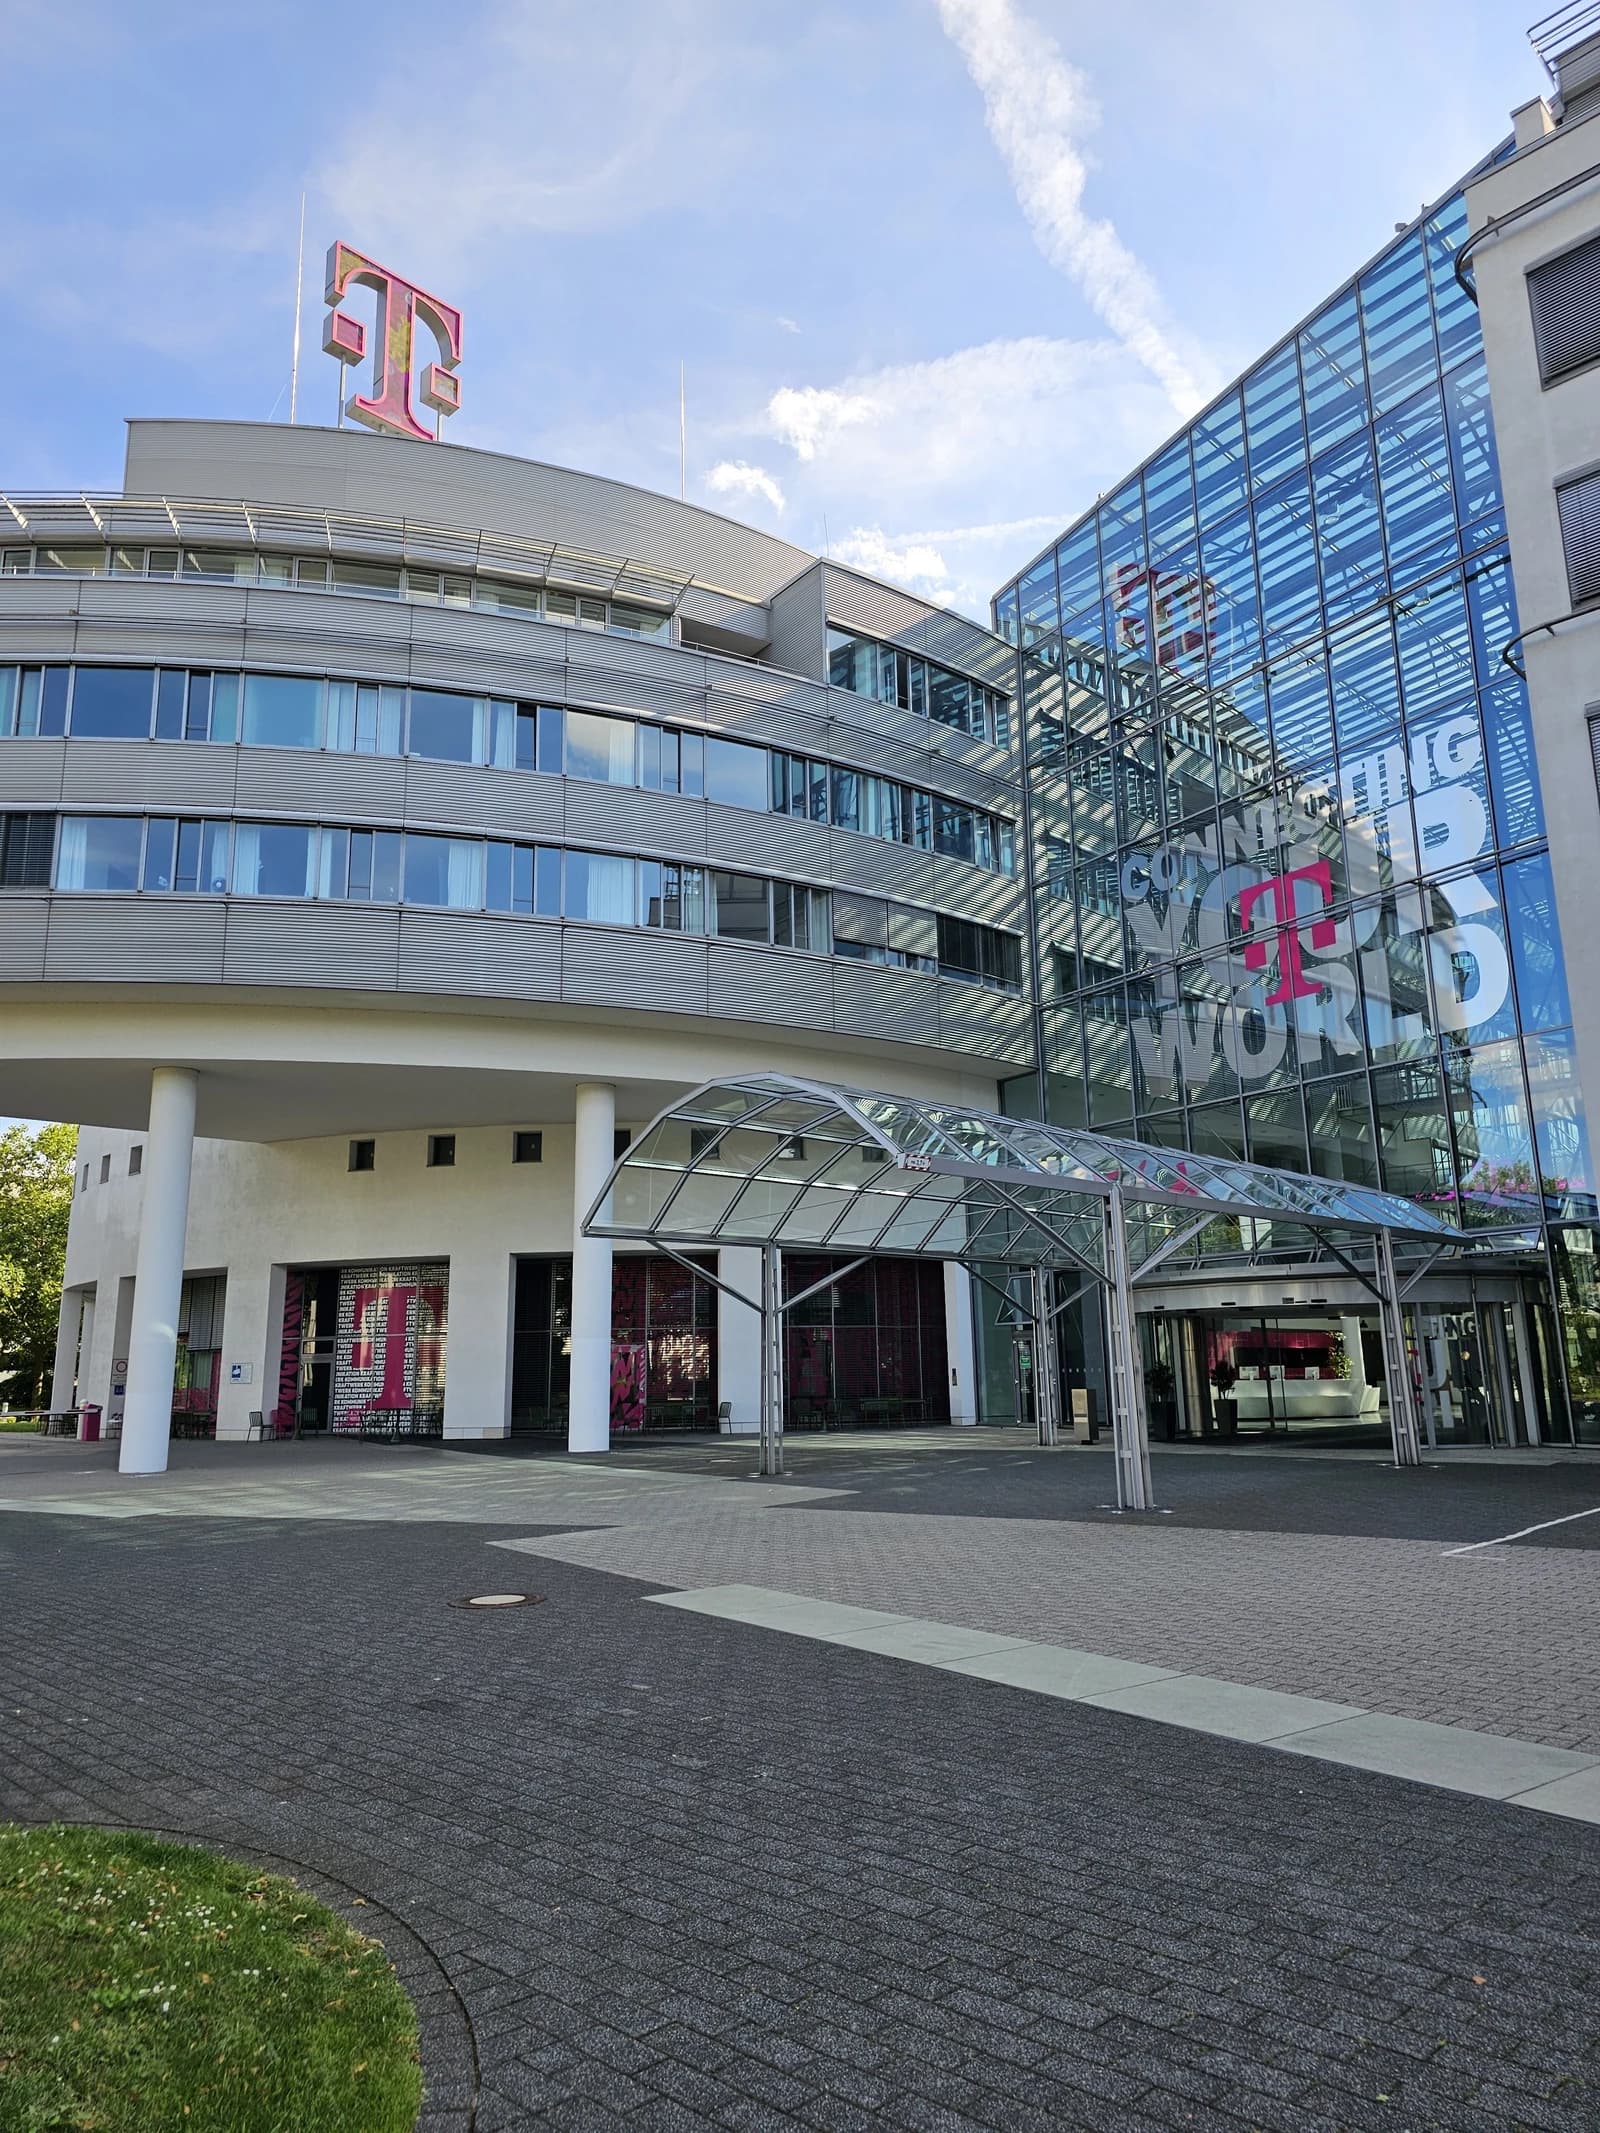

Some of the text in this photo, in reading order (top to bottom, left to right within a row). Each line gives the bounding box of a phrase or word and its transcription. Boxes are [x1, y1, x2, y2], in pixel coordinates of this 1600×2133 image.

[322, 240, 463, 441] T
[1121, 717, 1482, 901] CONNECTING
[1125, 785, 1498, 1008] YOUR
[1131, 923, 1509, 1099] WORLD
[1240, 860, 1337, 1007] T
[352, 1287, 444, 1409] T
